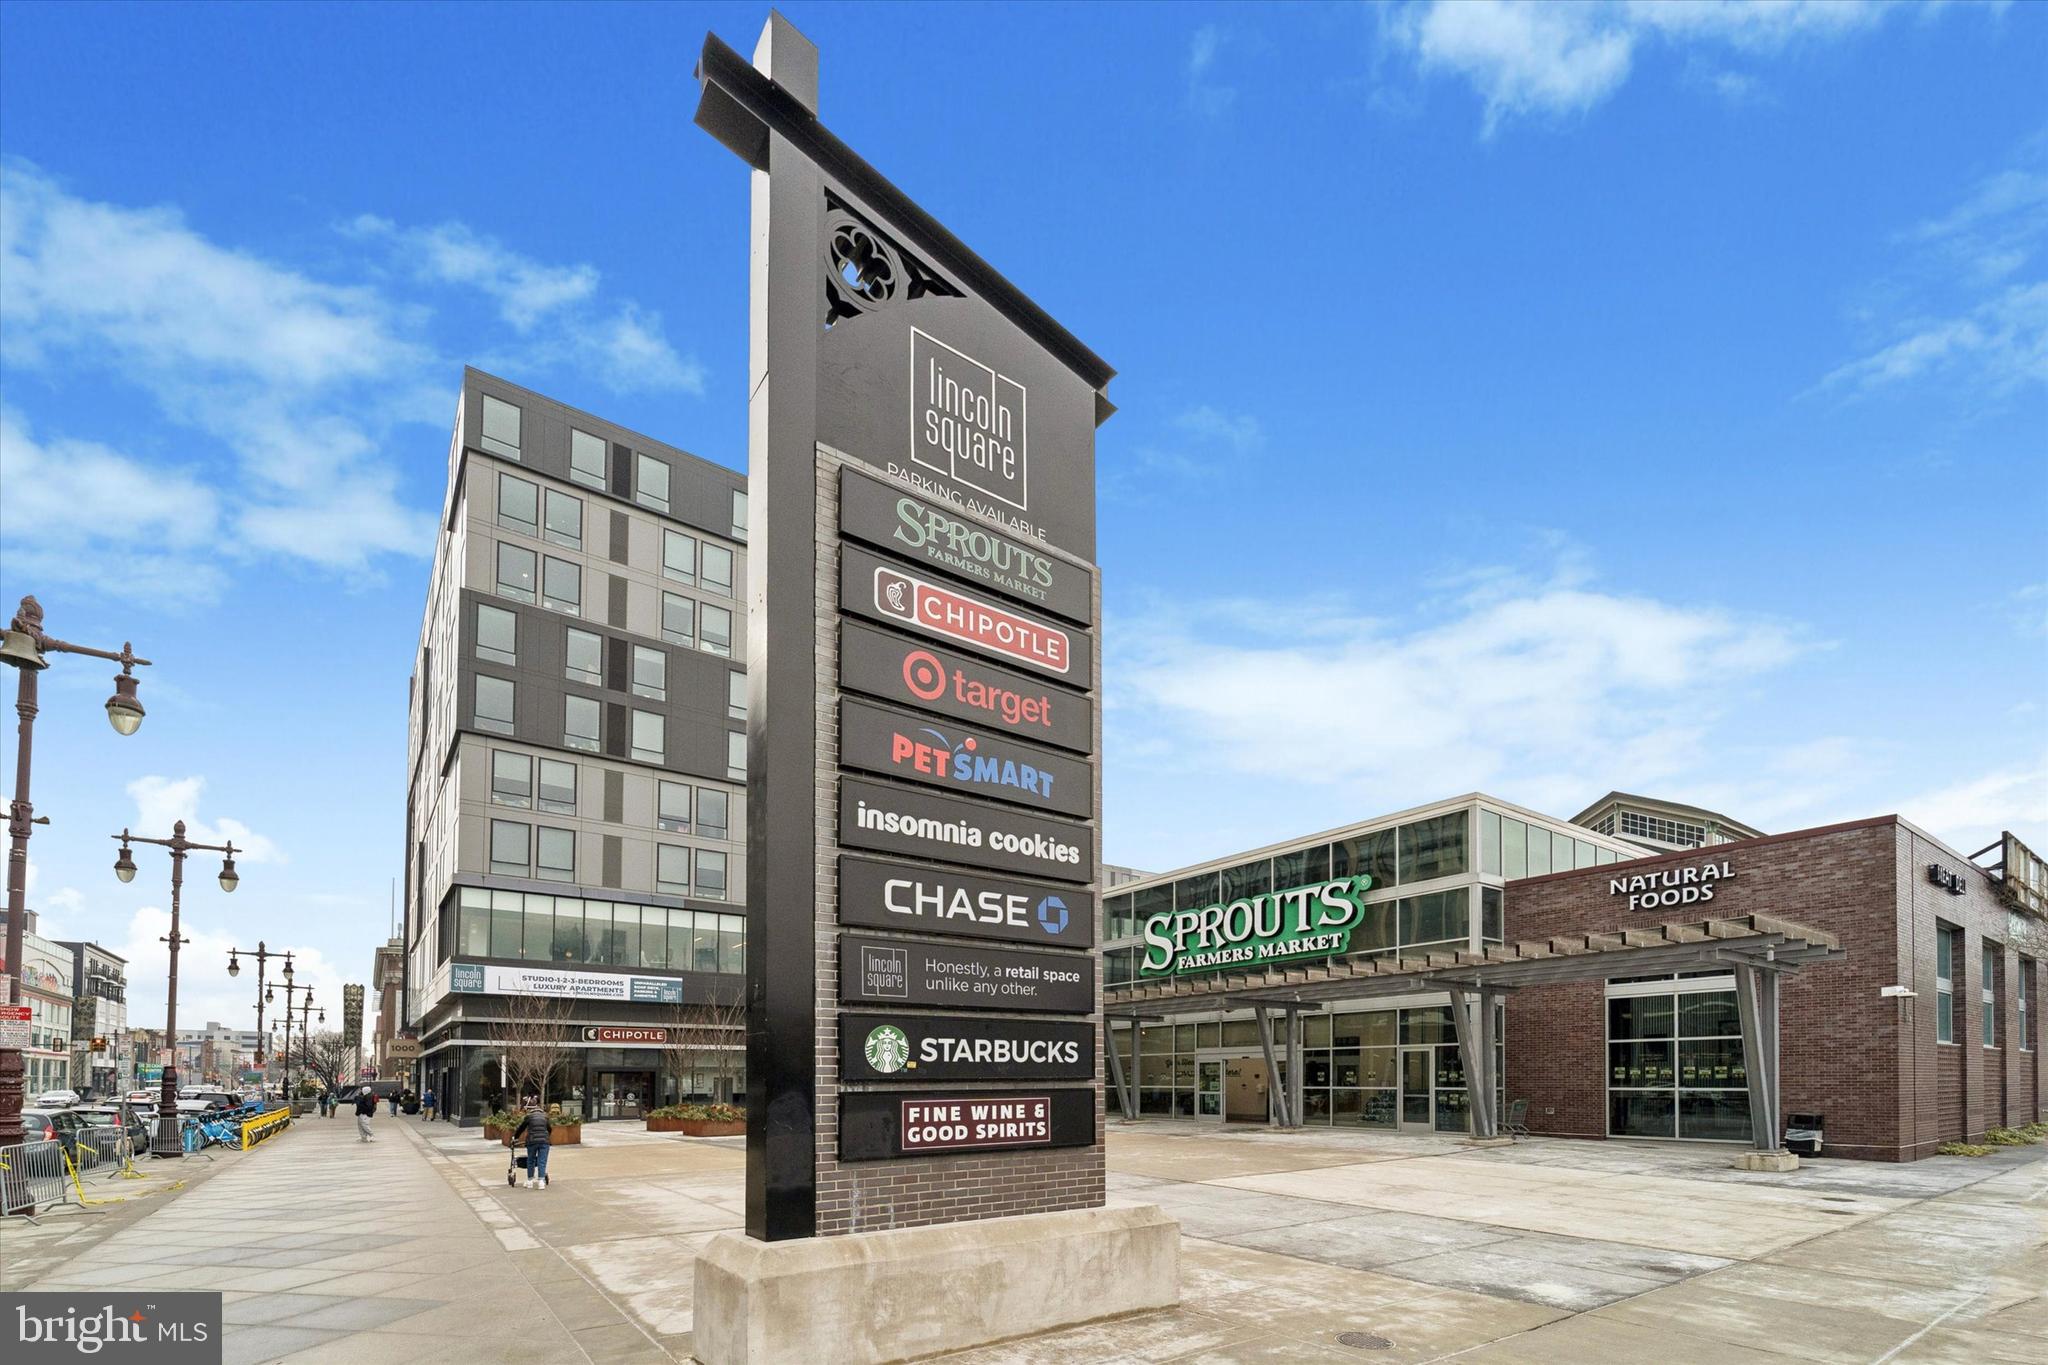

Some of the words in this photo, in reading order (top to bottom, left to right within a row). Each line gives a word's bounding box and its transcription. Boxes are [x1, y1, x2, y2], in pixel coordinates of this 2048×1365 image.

[930, 357, 1011, 441] lincoln
[926, 410, 1014, 480] square
[887, 462, 962, 506] PARKING
[966, 498, 1047, 543] AVAILABLE
[893, 498, 1053, 587] SPROUTS
[927, 546, 991, 578] FARMERS
[993, 572, 1047, 600] MARKET
[924, 596, 1060, 661] CHIPOTLE
[953, 669, 1052, 727] target
[857, 800, 982, 847] insomnia
[989, 830, 1080, 864] cookies
[1610, 861, 1736, 895] NATURAL
[884, 878, 1030, 927] CHASE
[1629, 884, 1714, 910] FOODS
[1141, 880, 1354, 970] SPROUTS
[868, 953, 902, 974] lincoln
[1178, 946, 1254, 969] FARMERS
[1258, 932, 1342, 958] MARKET
[453, 978, 482, 990] square
[455, 966, 481, 979] lincoln
[867, 972, 903, 989] square
[925, 958, 990, 978] Honestly,
[993, 966, 1002, 977] a
[1005, 966, 1039, 980] retail
[1043, 970, 1080, 983] space
[533, 983, 567, 991] LUXURY
[569, 985, 625, 994] APARTMENTS
[925, 977, 969, 991] unlike
[973, 983, 998, 996] any
[1001, 982, 1038, 996] other.
[603, 1030, 664, 1040] CHIPOTLE
[919, 1037, 1079, 1064] STARBUCKS
[908, 1106, 961, 1123] FINE
[971, 1104, 1026, 1121] WINE
[1034, 1103, 1044, 1119] &
[907, 1125, 968, 1142] GOOD
[976, 1122, 1046, 1139] SPIRITS
